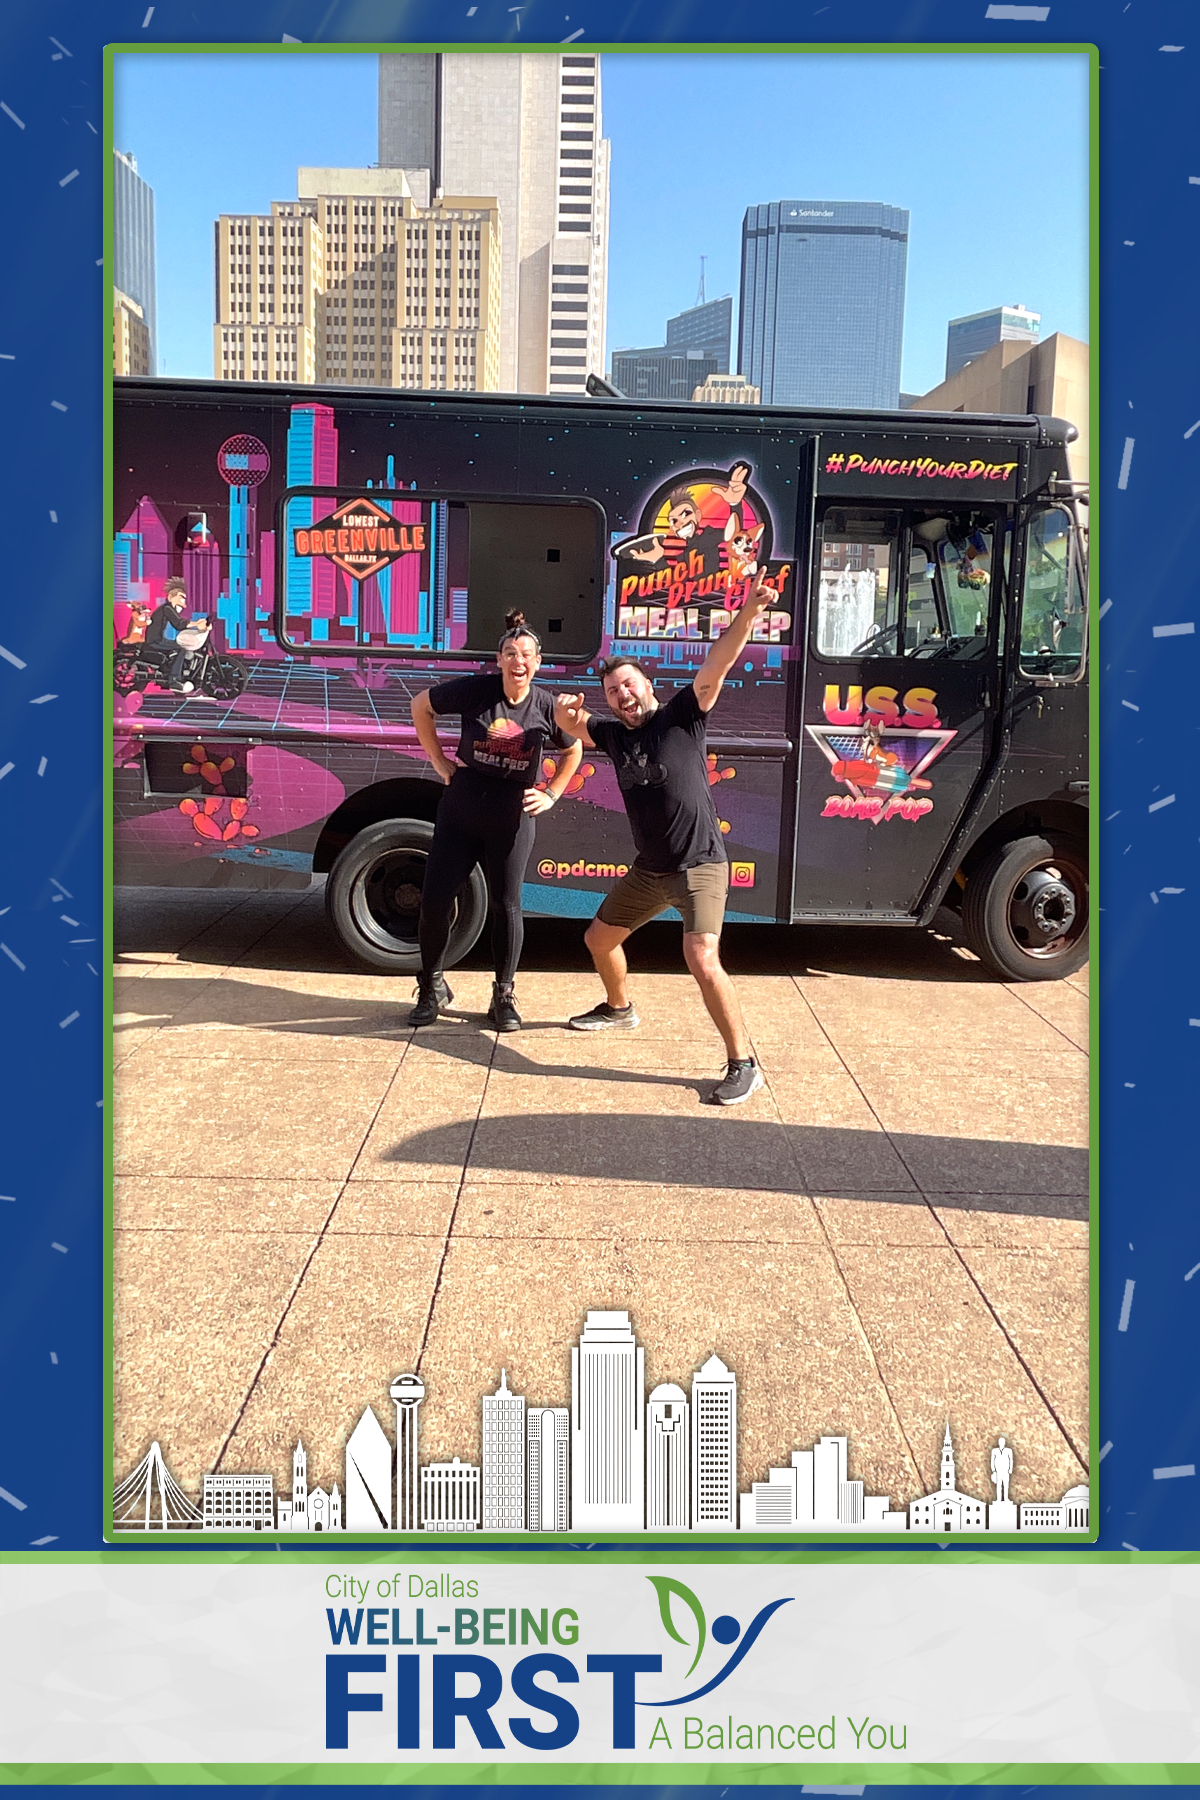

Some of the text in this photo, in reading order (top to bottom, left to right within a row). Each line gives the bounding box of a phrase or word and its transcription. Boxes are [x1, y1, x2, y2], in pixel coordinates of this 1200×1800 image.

[798, 209, 834, 218] Santander
[342, 514, 380, 527] LOWEST
[296, 526, 426, 555] GREENVILLE
[619, 549, 705, 605] Punch
[618, 606, 791, 642] MEAL PEP
[823, 684, 942, 729] U.S.S.
[820, 795, 934, 823] BOMB POP
[537, 858, 632, 879] @pdcme
